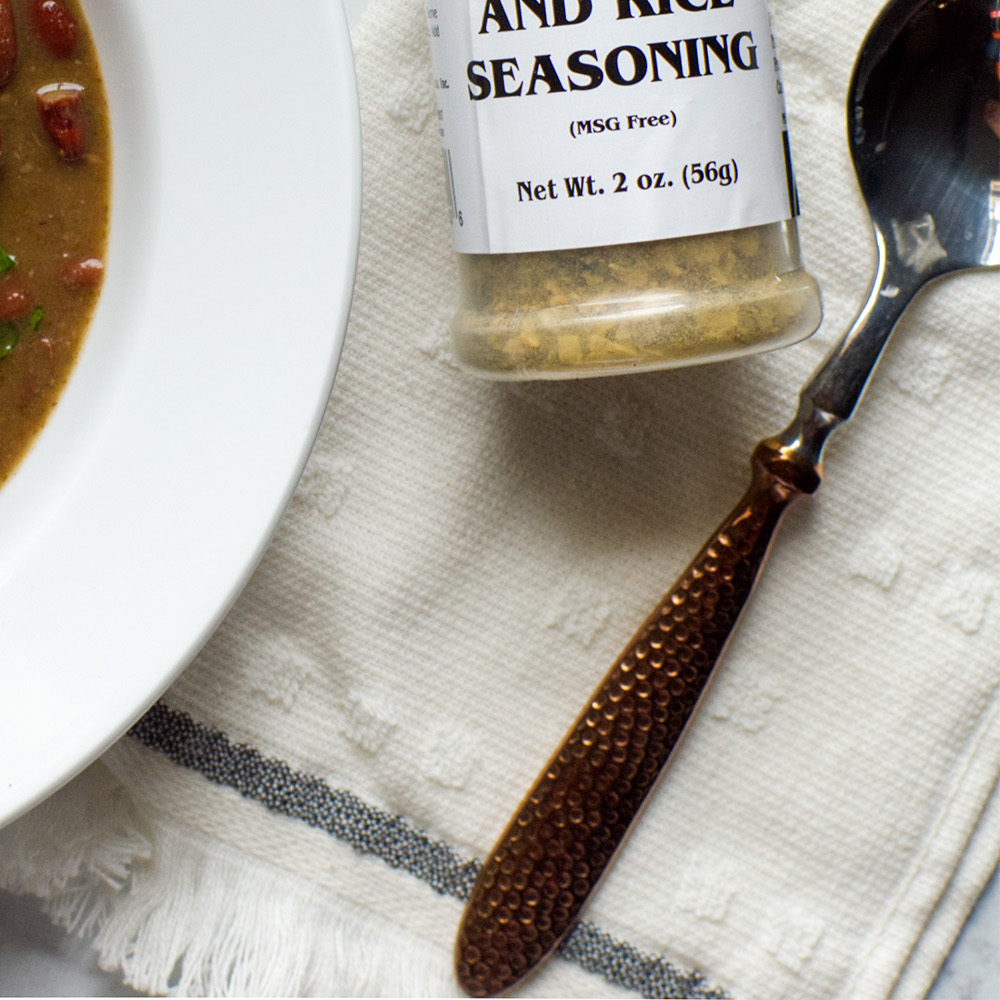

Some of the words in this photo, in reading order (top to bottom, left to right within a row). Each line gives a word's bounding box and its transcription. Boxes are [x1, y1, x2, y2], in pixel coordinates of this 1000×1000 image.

[466, 31, 760, 101] SEASONING
[569, 117, 621, 139] (MSG
[626, 110, 678, 130] Free)
[516, 179, 558, 202] Net
[564, 175, 605, 198] Wt.
[612, 172, 628, 193] 2
[636, 172, 674, 190] oz.
[682, 158, 739, 190] (56g)
